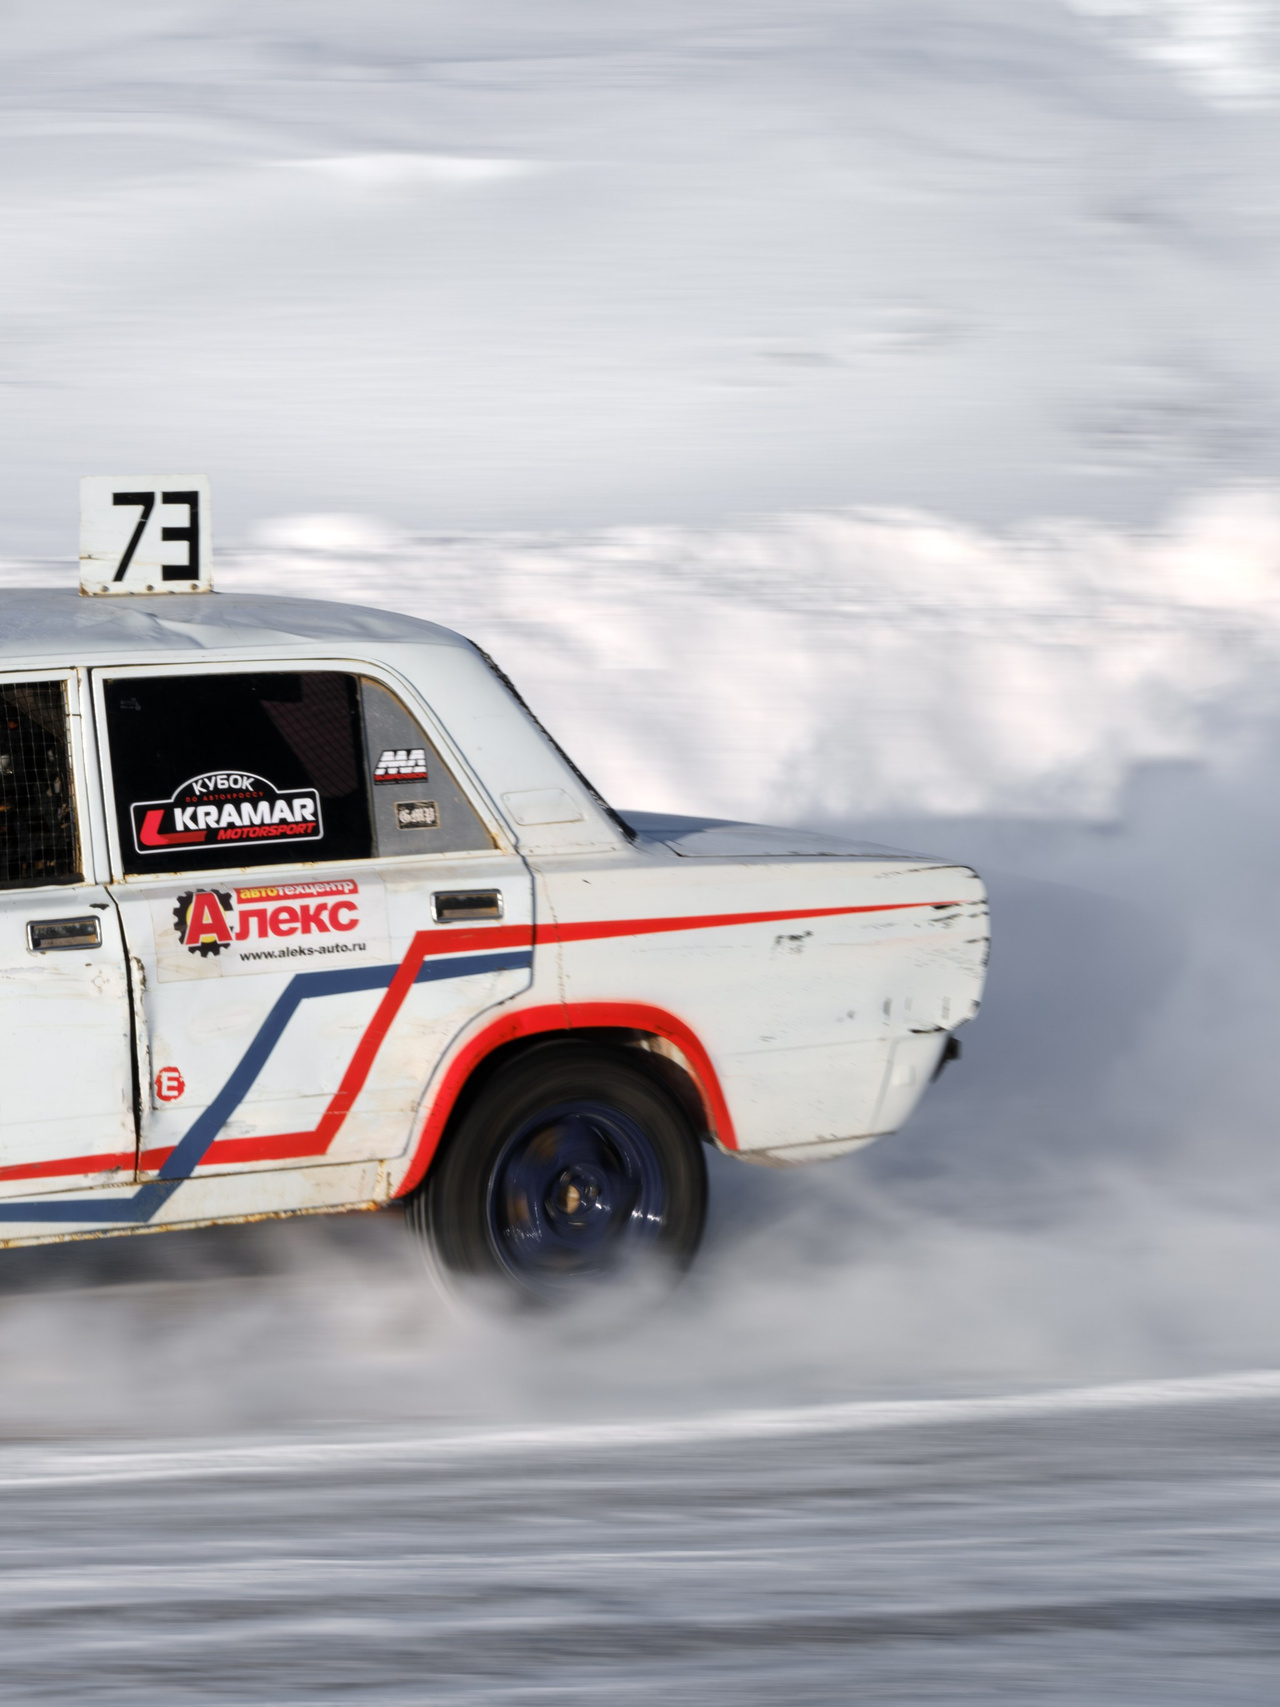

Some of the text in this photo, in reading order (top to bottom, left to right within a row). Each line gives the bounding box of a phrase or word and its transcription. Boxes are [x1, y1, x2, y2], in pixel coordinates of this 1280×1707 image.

[111, 490, 200, 582] 73
[191, 774, 256, 796] КУБОК
[173, 798, 316, 832] KRAMAR
[217, 822, 317, 841] MOTORSPORT
[239, 880, 355, 900] автотехцентр
[185, 892, 360, 946] Алекс
[239, 942, 367, 962] www.aleks-auto.ru
[161, 1071, 180, 1097] E
